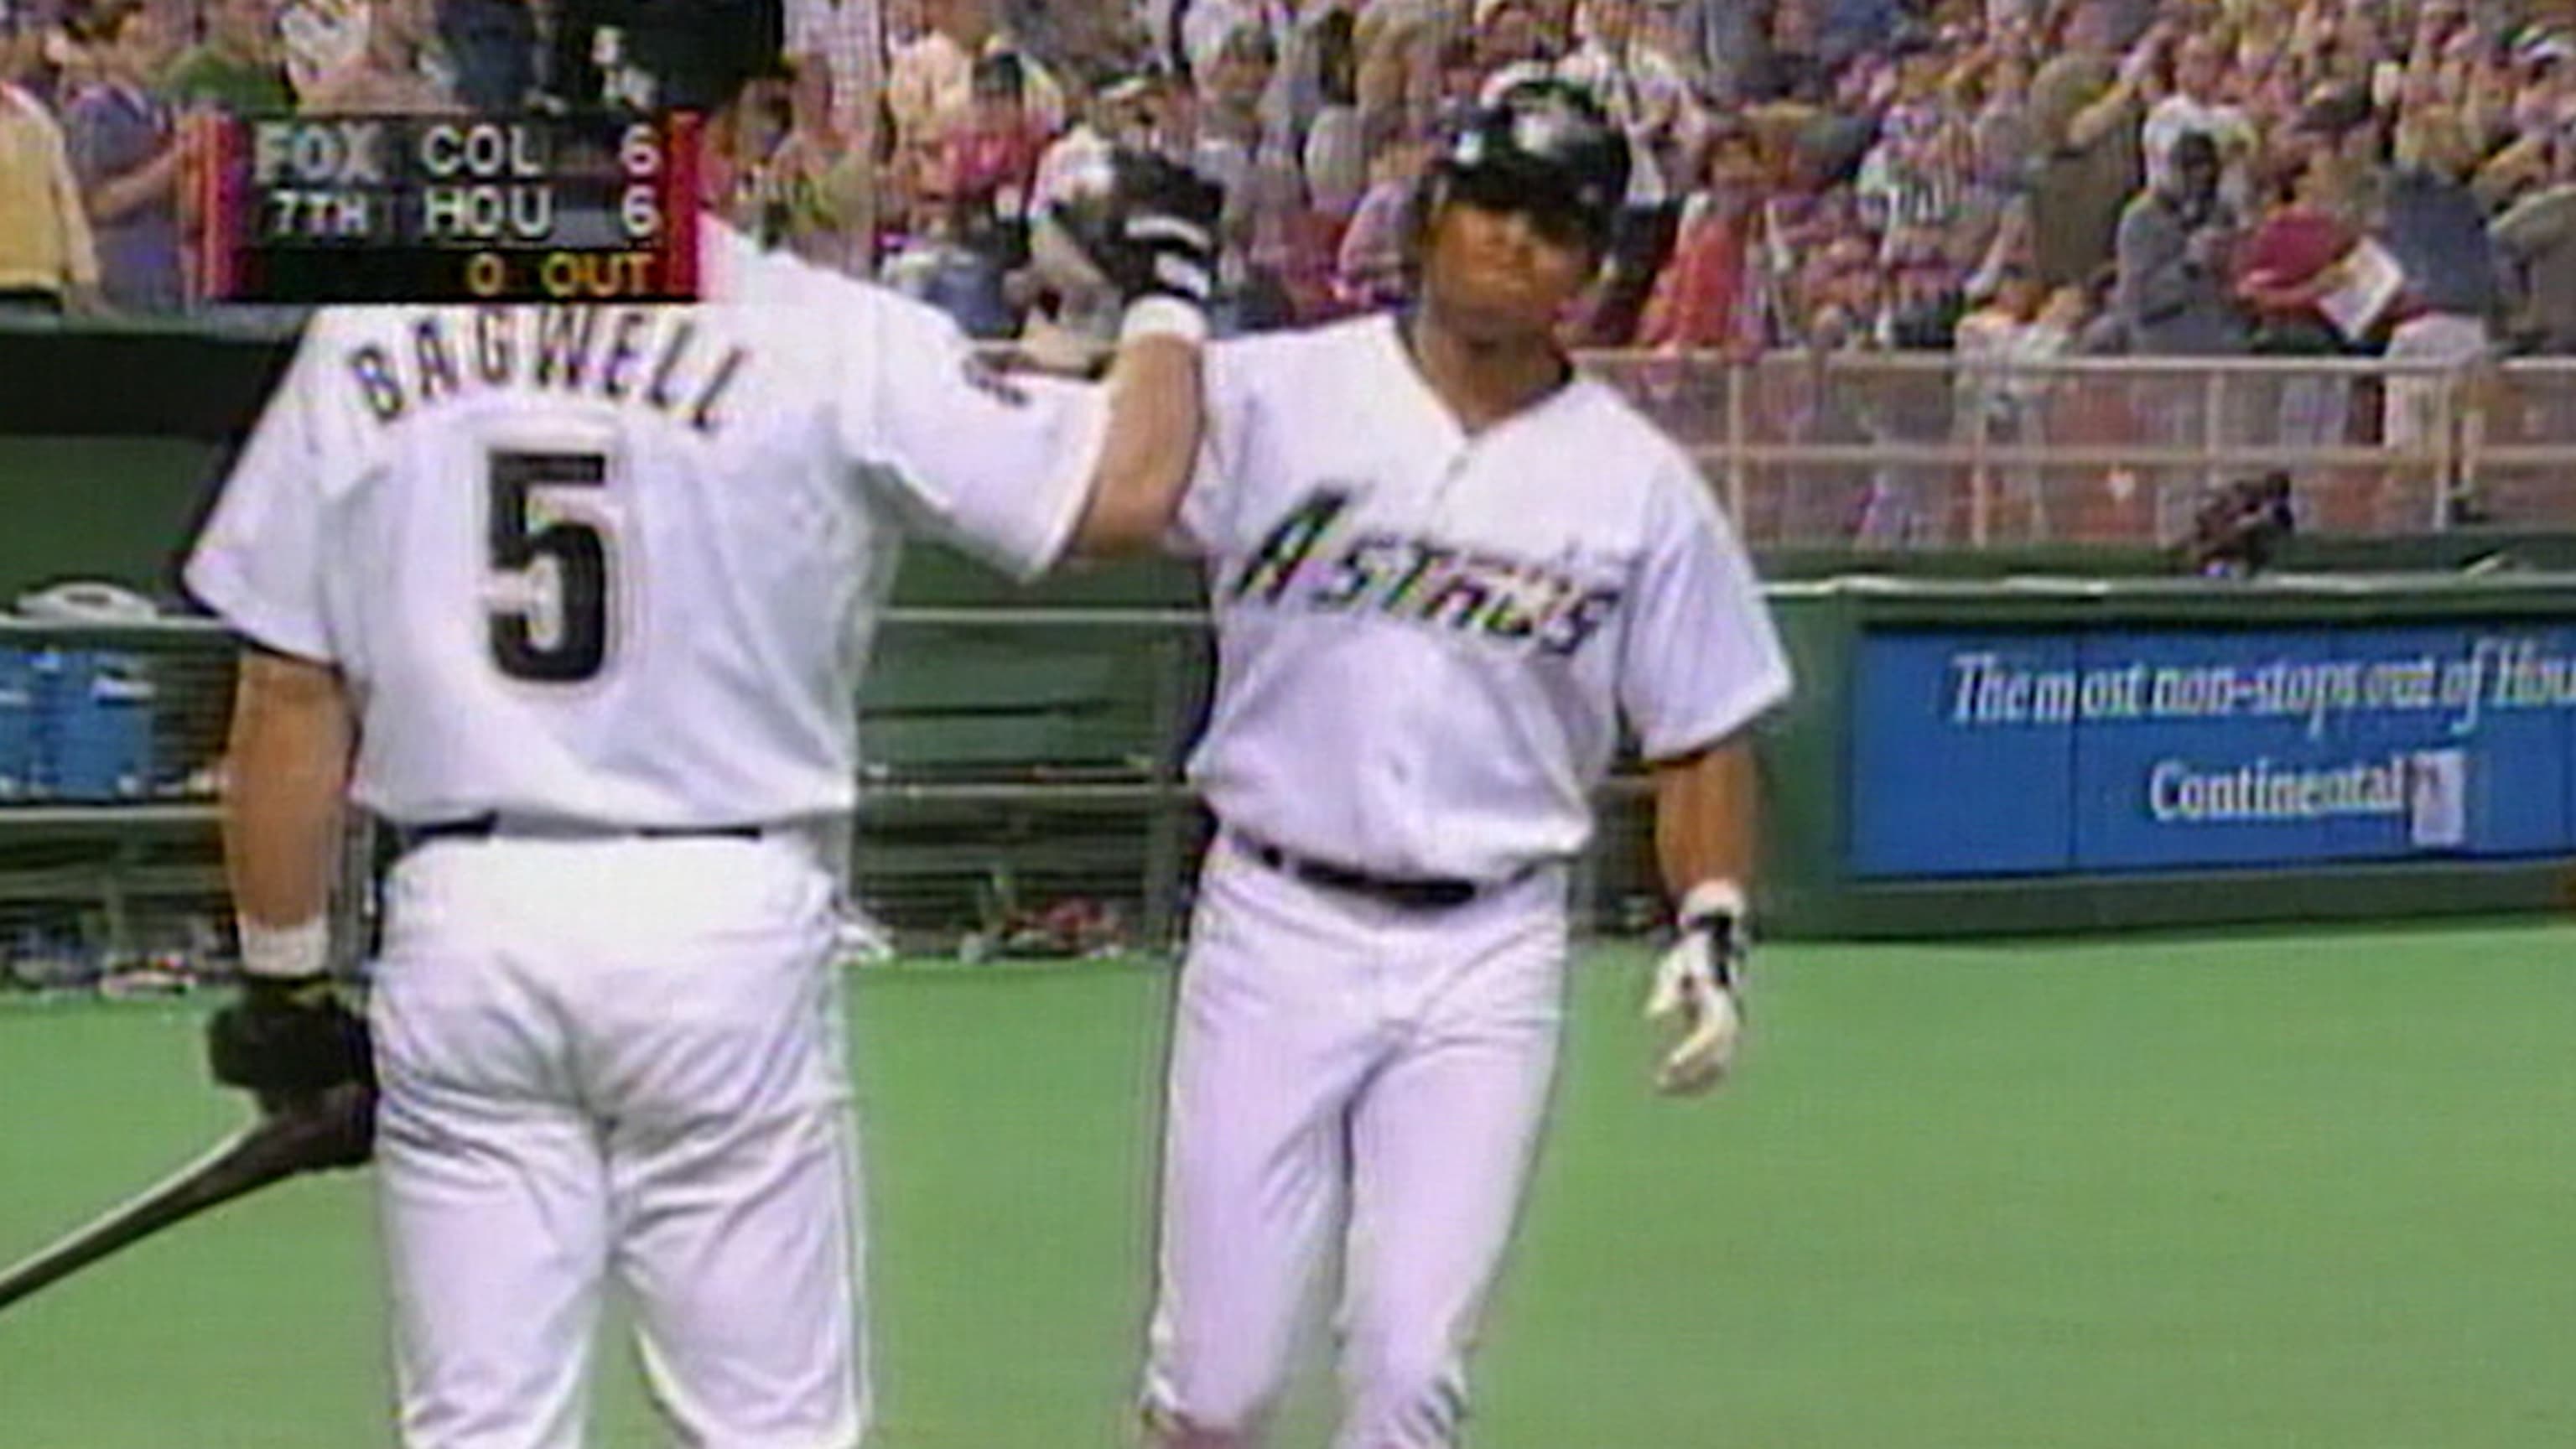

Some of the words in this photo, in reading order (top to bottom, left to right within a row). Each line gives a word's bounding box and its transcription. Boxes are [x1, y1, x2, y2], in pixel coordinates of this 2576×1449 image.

[351, 304, 745, 431] BAGWELL
[486, 449, 610, 686] 5
[1952, 652, 2029, 724] The
[2032, 662, 2143, 723] most
[2151, 659, 2358, 740] non-stops
[2365, 658, 2434, 708] out
[2440, 639, 2488, 736] of
[2148, 756, 2403, 822] Continental
